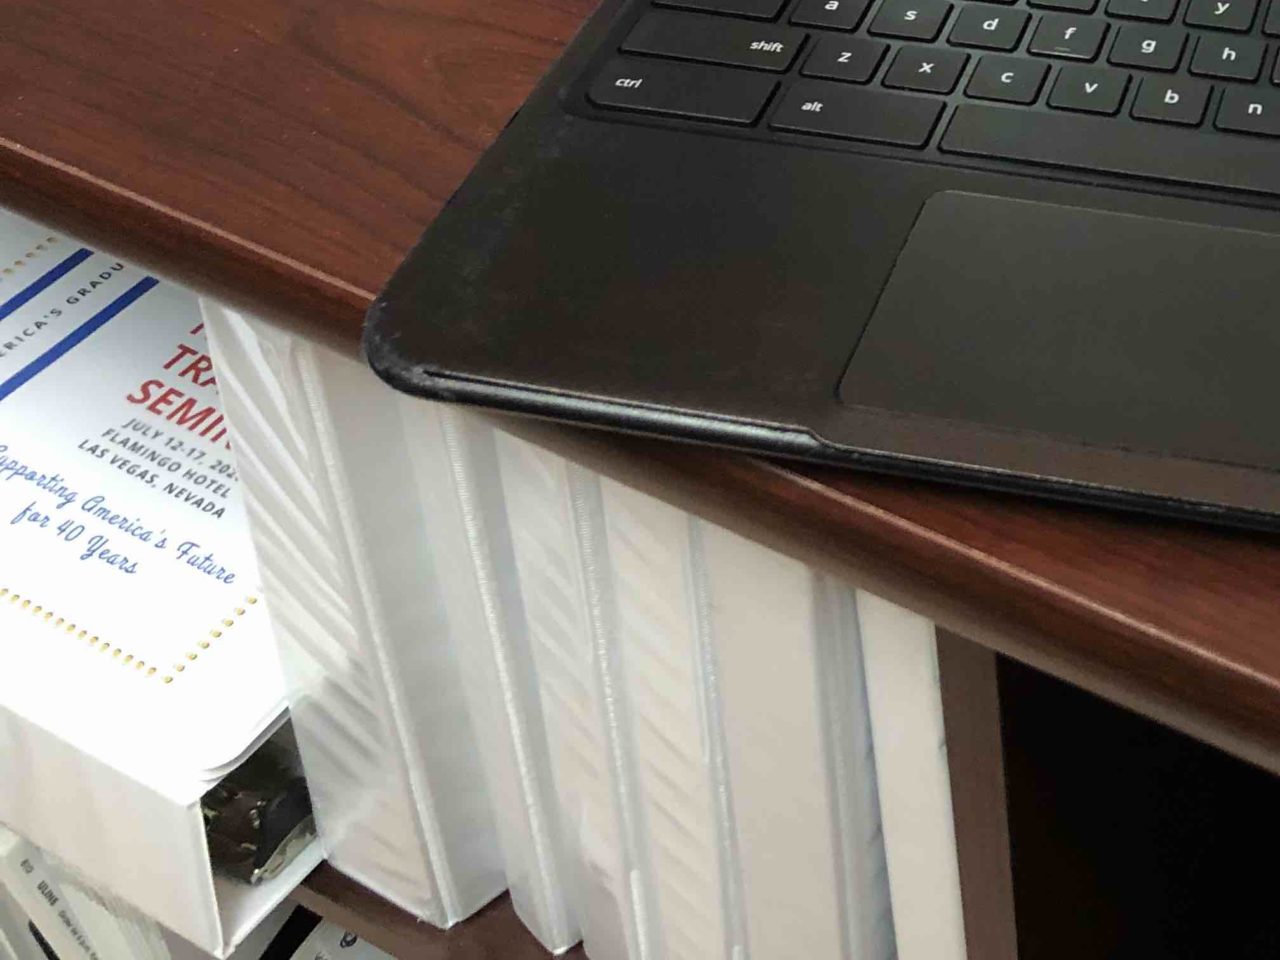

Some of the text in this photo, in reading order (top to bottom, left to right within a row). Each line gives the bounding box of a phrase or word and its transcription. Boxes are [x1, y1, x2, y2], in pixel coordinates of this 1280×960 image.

[824, 0, 840, 11] a
[1214, 2, 1230, 15] y
[904, 10, 918, 21] s
[982, 18, 999, 31] d
[1064, 27, 1077, 40] f
[749, 40, 784, 53] shift
[1141, 39, 1157, 54] g
[837, 51, 852, 63] z
[1222, 47, 1236, 61] h
[918, 62, 935, 74] x
[615, 78, 643, 88] ctrl
[1000, 72, 1014, 83] c
[1084, 82, 1099, 93] v
[1164, 89, 1180, 104] b
[801, 101, 824, 112] alt
[1247, 103, 1263, 115] n
[0, 308, 62, 357] RICA'S
[122, 418, 164, 440] JULY
[165, 437, 207, 466] 12-17,
[101, 428, 231, 499] FLAMINGO HOTEL
[78, 439, 226, 520] LAS VEGAS, NEVADA
[10, 500, 140, 575] for 40 Years
[81, 495, 168, 549] America's
[176, 541, 237, 584] Future
